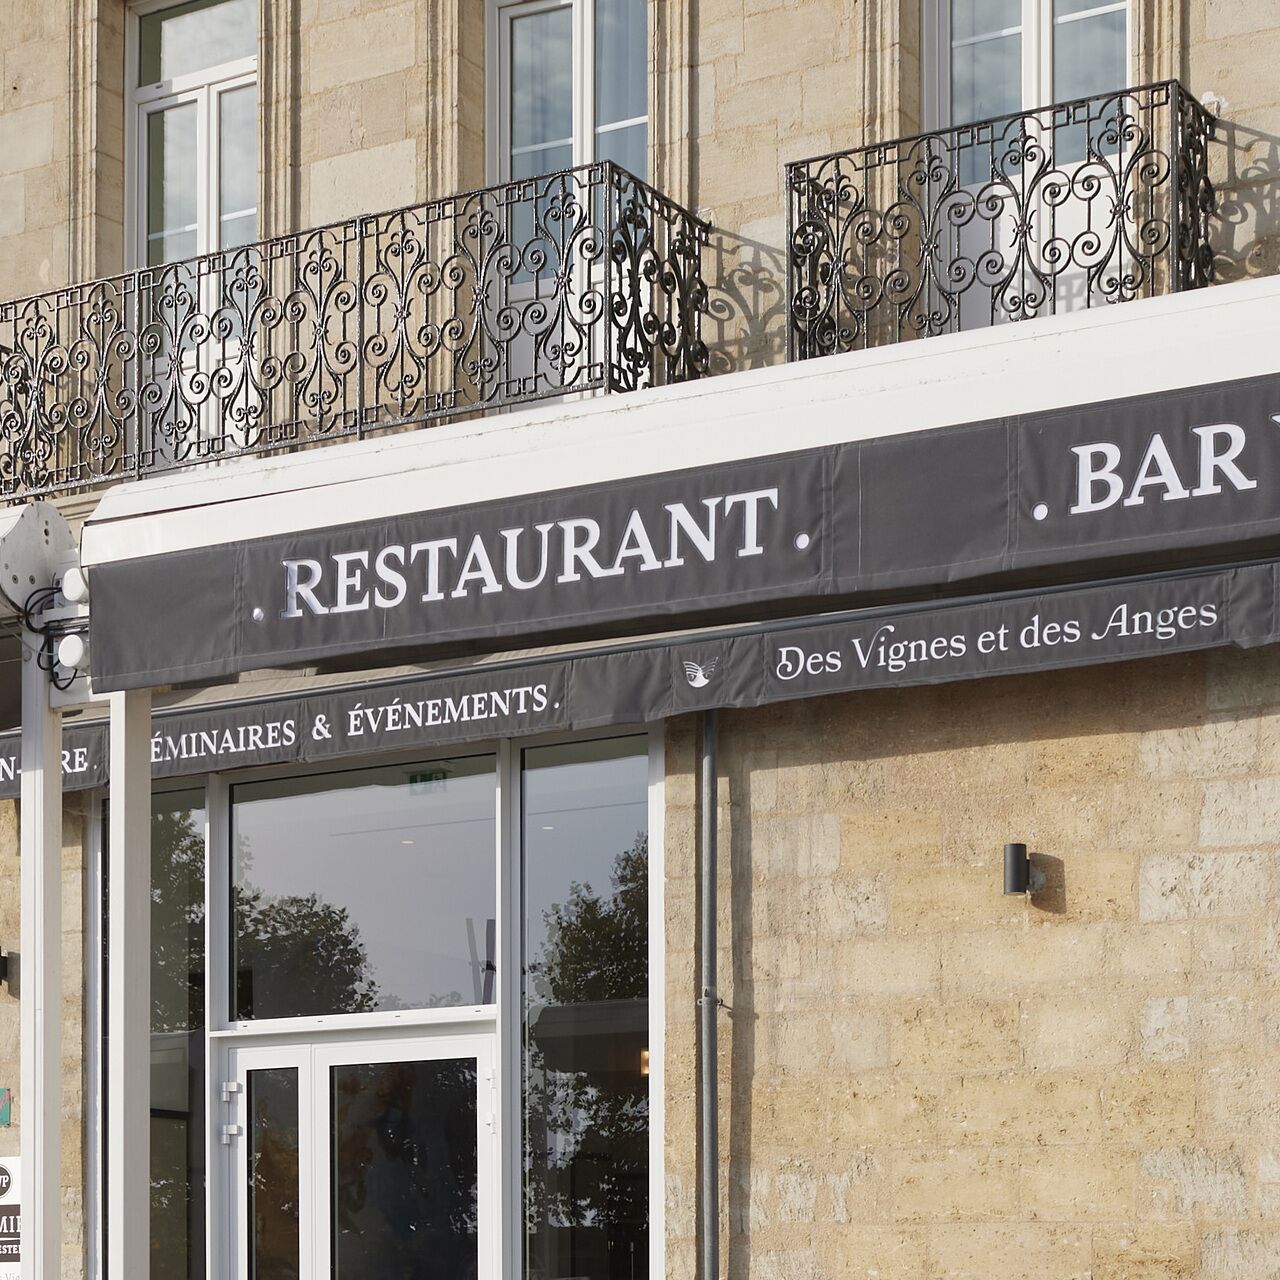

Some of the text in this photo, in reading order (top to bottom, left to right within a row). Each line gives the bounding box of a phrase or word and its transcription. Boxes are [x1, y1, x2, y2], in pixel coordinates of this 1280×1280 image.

[1070, 423, 1258, 515] BAR
[279, 488, 778, 618] RESTAURANT
[776, 603, 1218, 680] Des Vignes et des Anges
[151, 719, 296, 763] ÉMINAIRES
[311, 714, 332, 741] &
